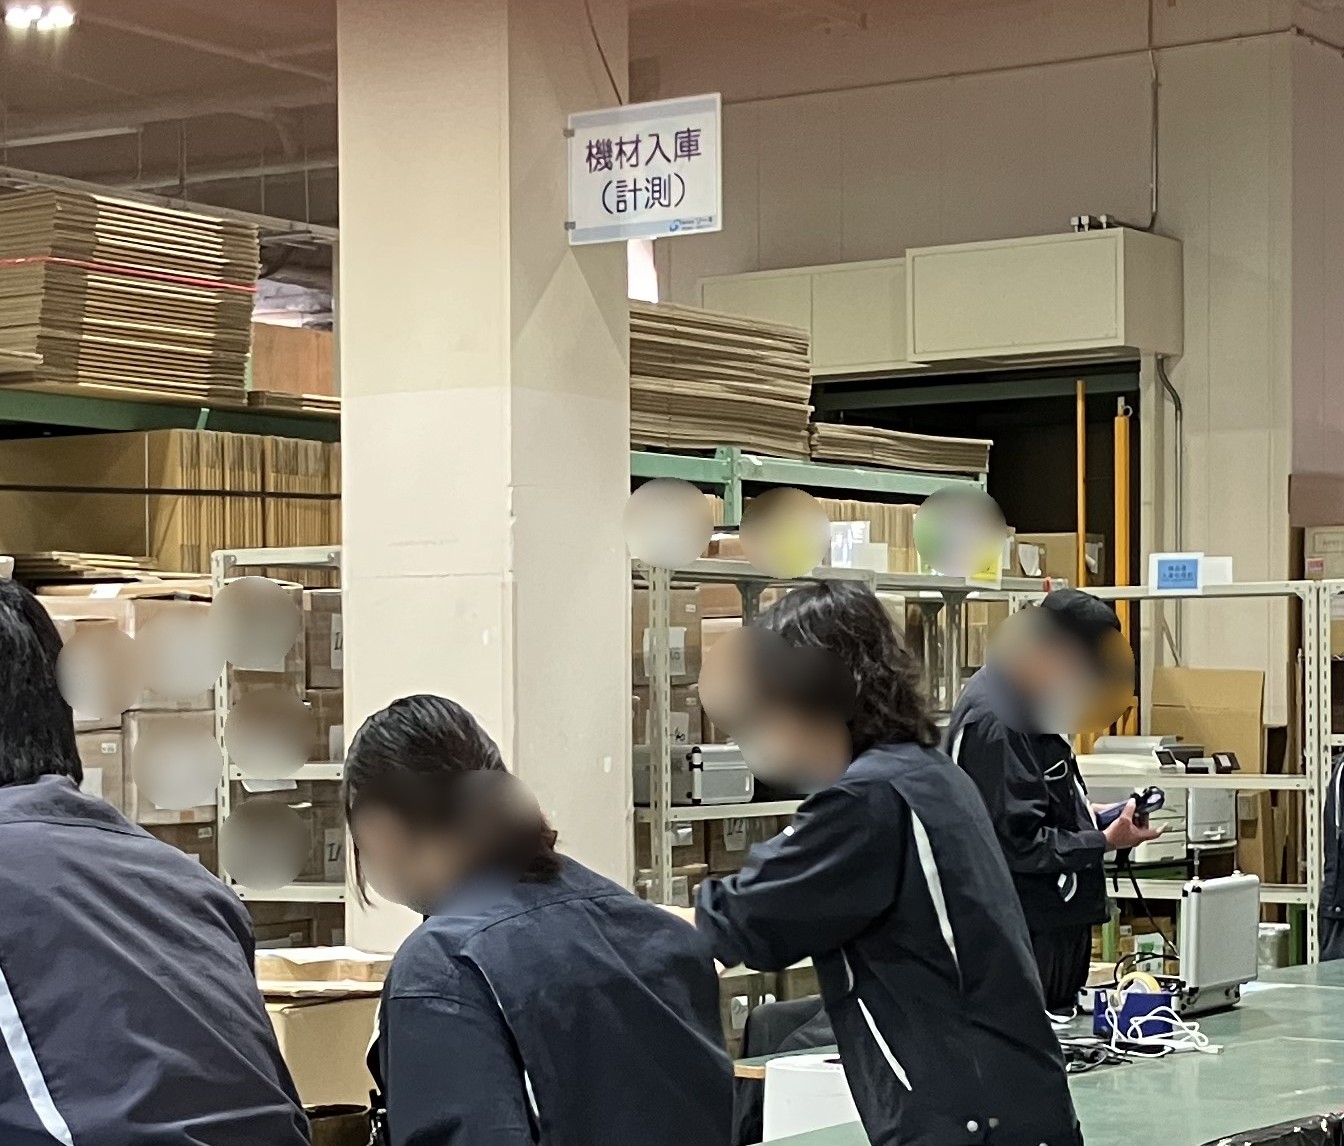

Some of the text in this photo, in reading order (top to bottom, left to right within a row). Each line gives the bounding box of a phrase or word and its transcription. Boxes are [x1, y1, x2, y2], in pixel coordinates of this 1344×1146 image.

[585, 128, 702, 174] 機材入庫
[602, 172, 685, 215] （計測）
